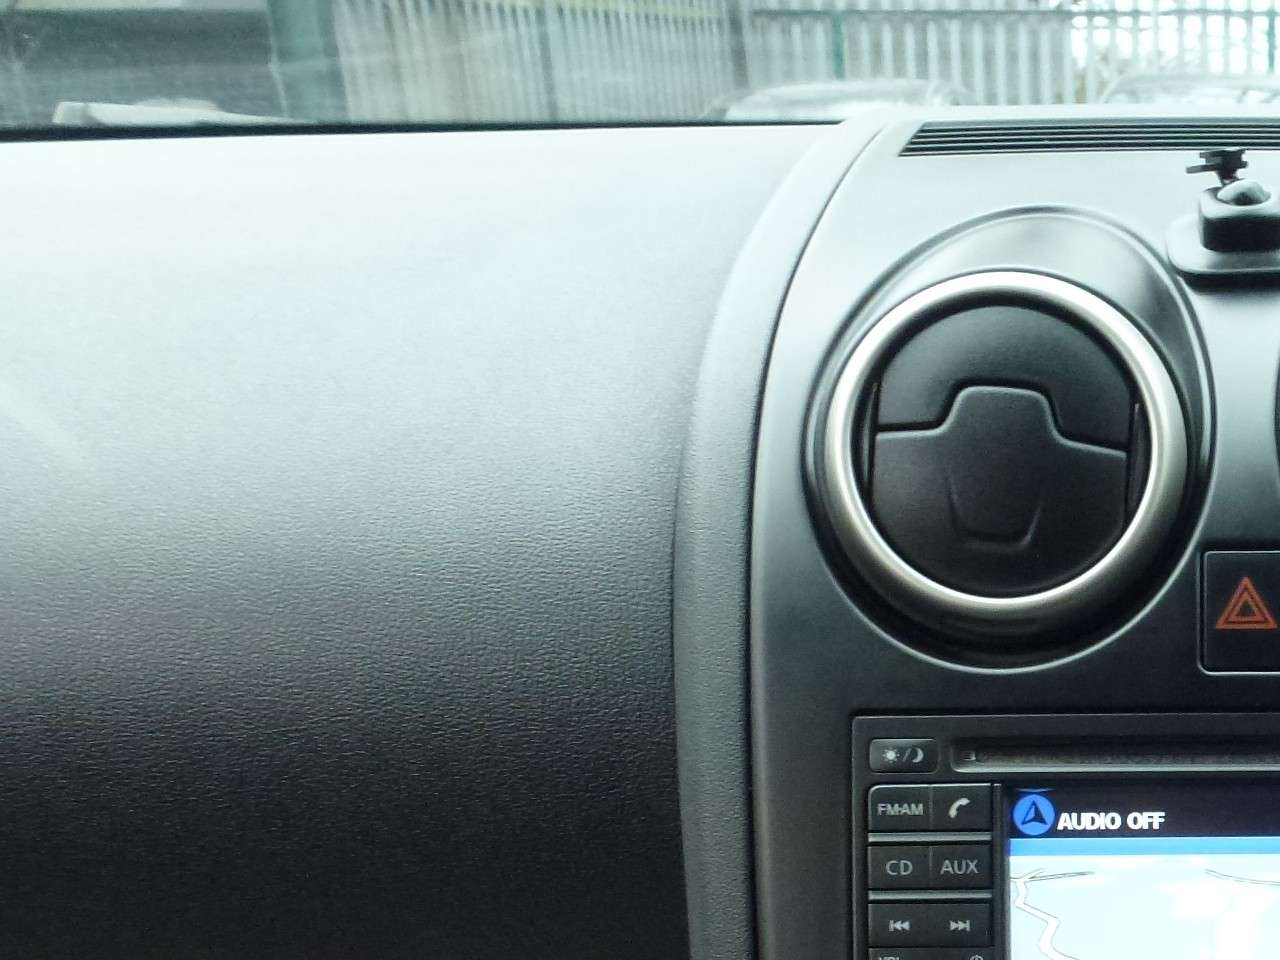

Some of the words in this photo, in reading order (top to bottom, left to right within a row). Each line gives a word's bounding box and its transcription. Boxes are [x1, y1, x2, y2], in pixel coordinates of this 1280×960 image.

[1057, 812, 1121, 831] AUDIO
[1126, 811, 1166, 830] OFF
[885, 859, 913, 876] CD
[940, 859, 979, 875] AUX
